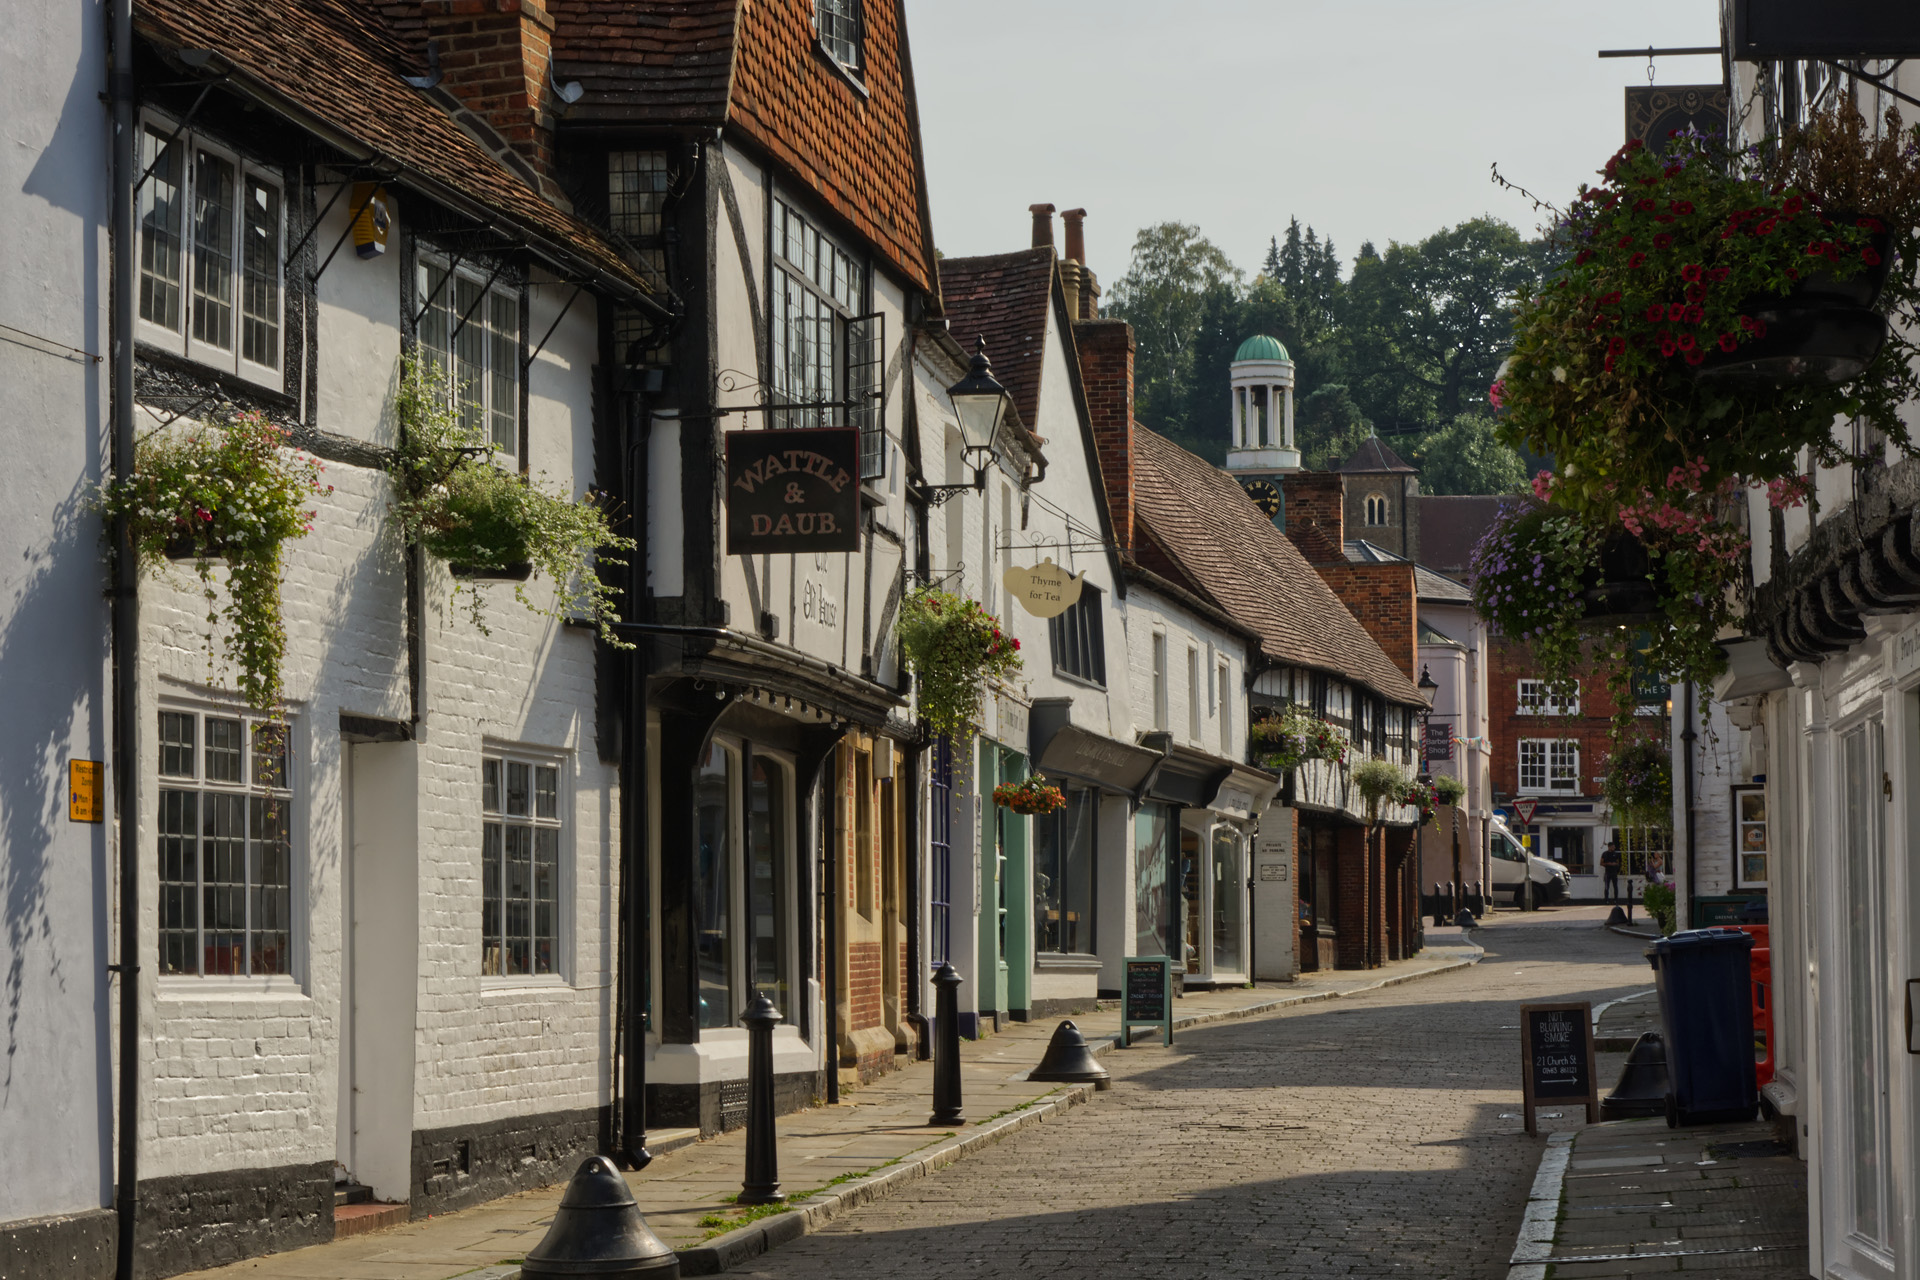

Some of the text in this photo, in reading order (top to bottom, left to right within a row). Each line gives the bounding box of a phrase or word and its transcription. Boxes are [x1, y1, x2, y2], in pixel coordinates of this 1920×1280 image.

[734, 450, 851, 494] WATTLE
[784, 481, 805, 504] &
[751, 513, 842, 536] DAUB.
[1030, 575, 1062, 588] Thyme
[1029, 590, 1061, 602] for Tea
[1638, 685, 1658, 695] THE
[1430, 728, 1444, 737] The
[1428, 747, 1447, 755] Shop
[1547, 1012, 1564, 1022] NOT
[1539, 1021, 1573, 1033] BLOWING
[1544, 1032, 1570, 1042] SMOKE
[1536, 1054, 1577, 1066] 21 Church St
